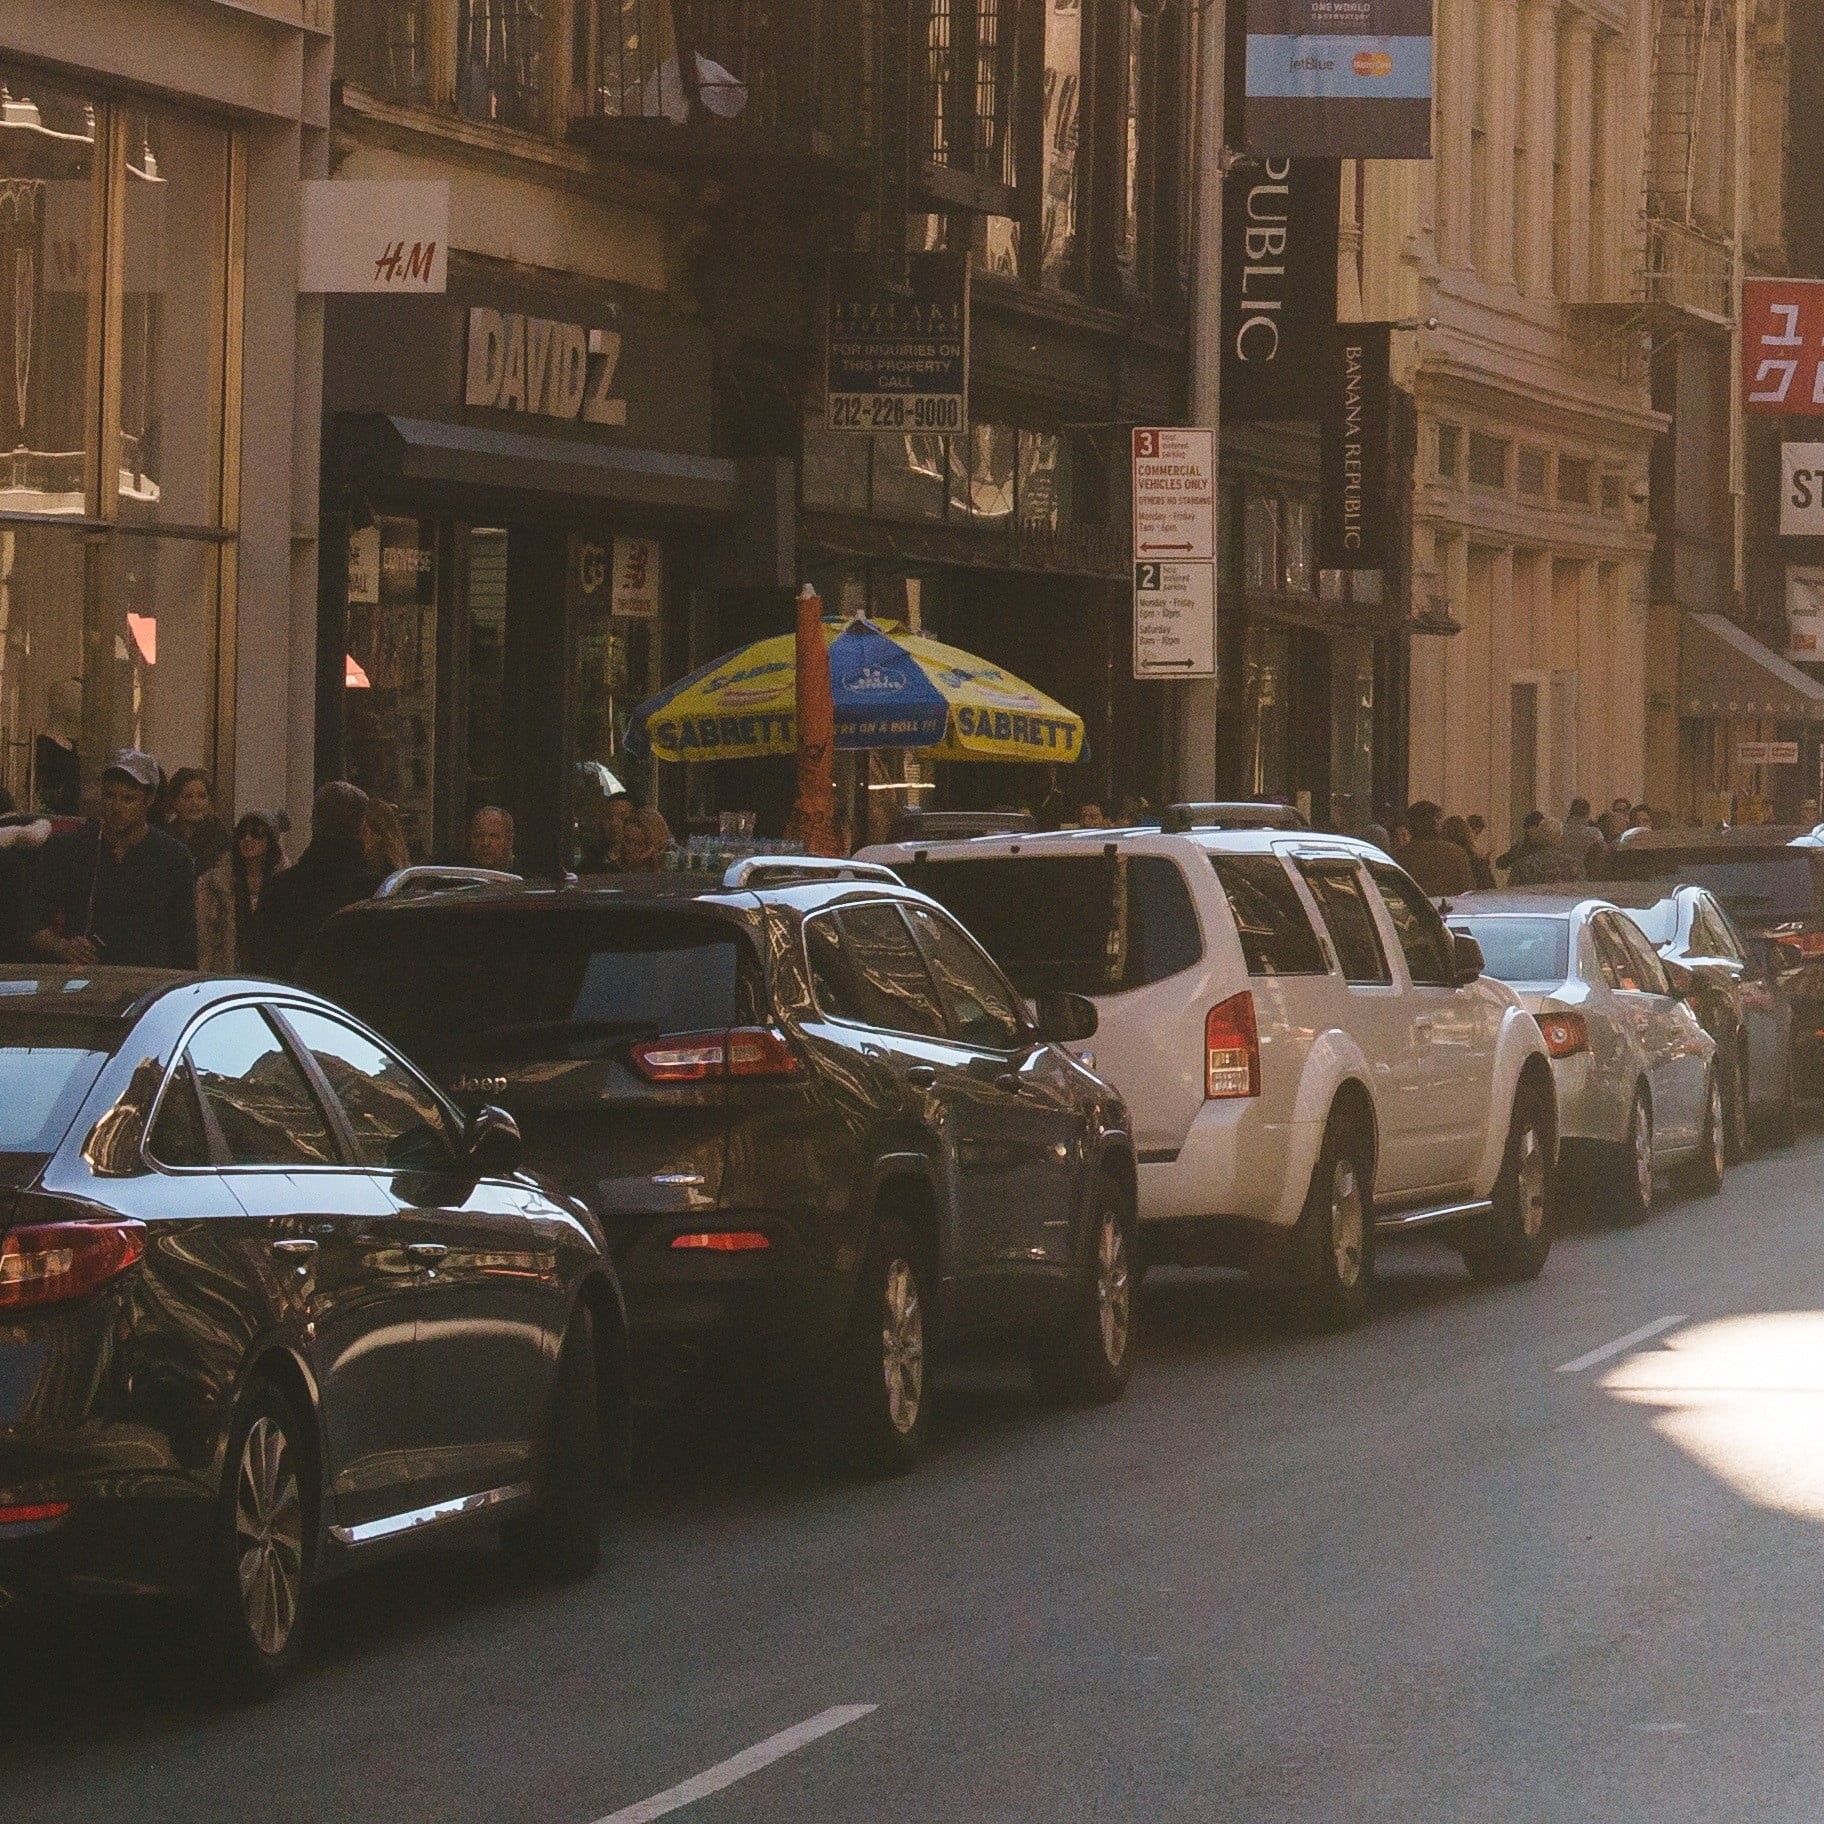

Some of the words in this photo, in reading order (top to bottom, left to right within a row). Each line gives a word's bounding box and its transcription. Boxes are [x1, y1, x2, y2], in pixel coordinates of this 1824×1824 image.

[1289, 56, 1334, 73] jetBlue
[374, 241, 437, 284] H&M
[832, 344, 861, 356] FOR
[864, 344, 936, 357] INQUIRIES
[939, 344, 960, 357] ON
[465, 306, 588, 420] DAVID
[583, 329, 628, 427] Z
[843, 359, 874, 372] THIS
[877, 359, 952, 373] PROPERTY
[878, 376, 914, 388] CALL
[1344, 346, 1362, 438] BANANA
[1140, 432, 1153, 456] 3
[1138, 465, 1202, 476] COMMERCIAL
[1138, 479, 1182, 490] VEHICLES
[1184, 478, 1208, 490] ONLY
[1343, 444, 1362, 550] REPUBLIC
[1142, 565, 1155, 588] 2
[657, 712, 794, 750] SABRETT
[891, 720, 918, 732] ROLL
[958, 705, 1078, 750] SABRETT
[449, 1073, 508, 1095] Jeep
